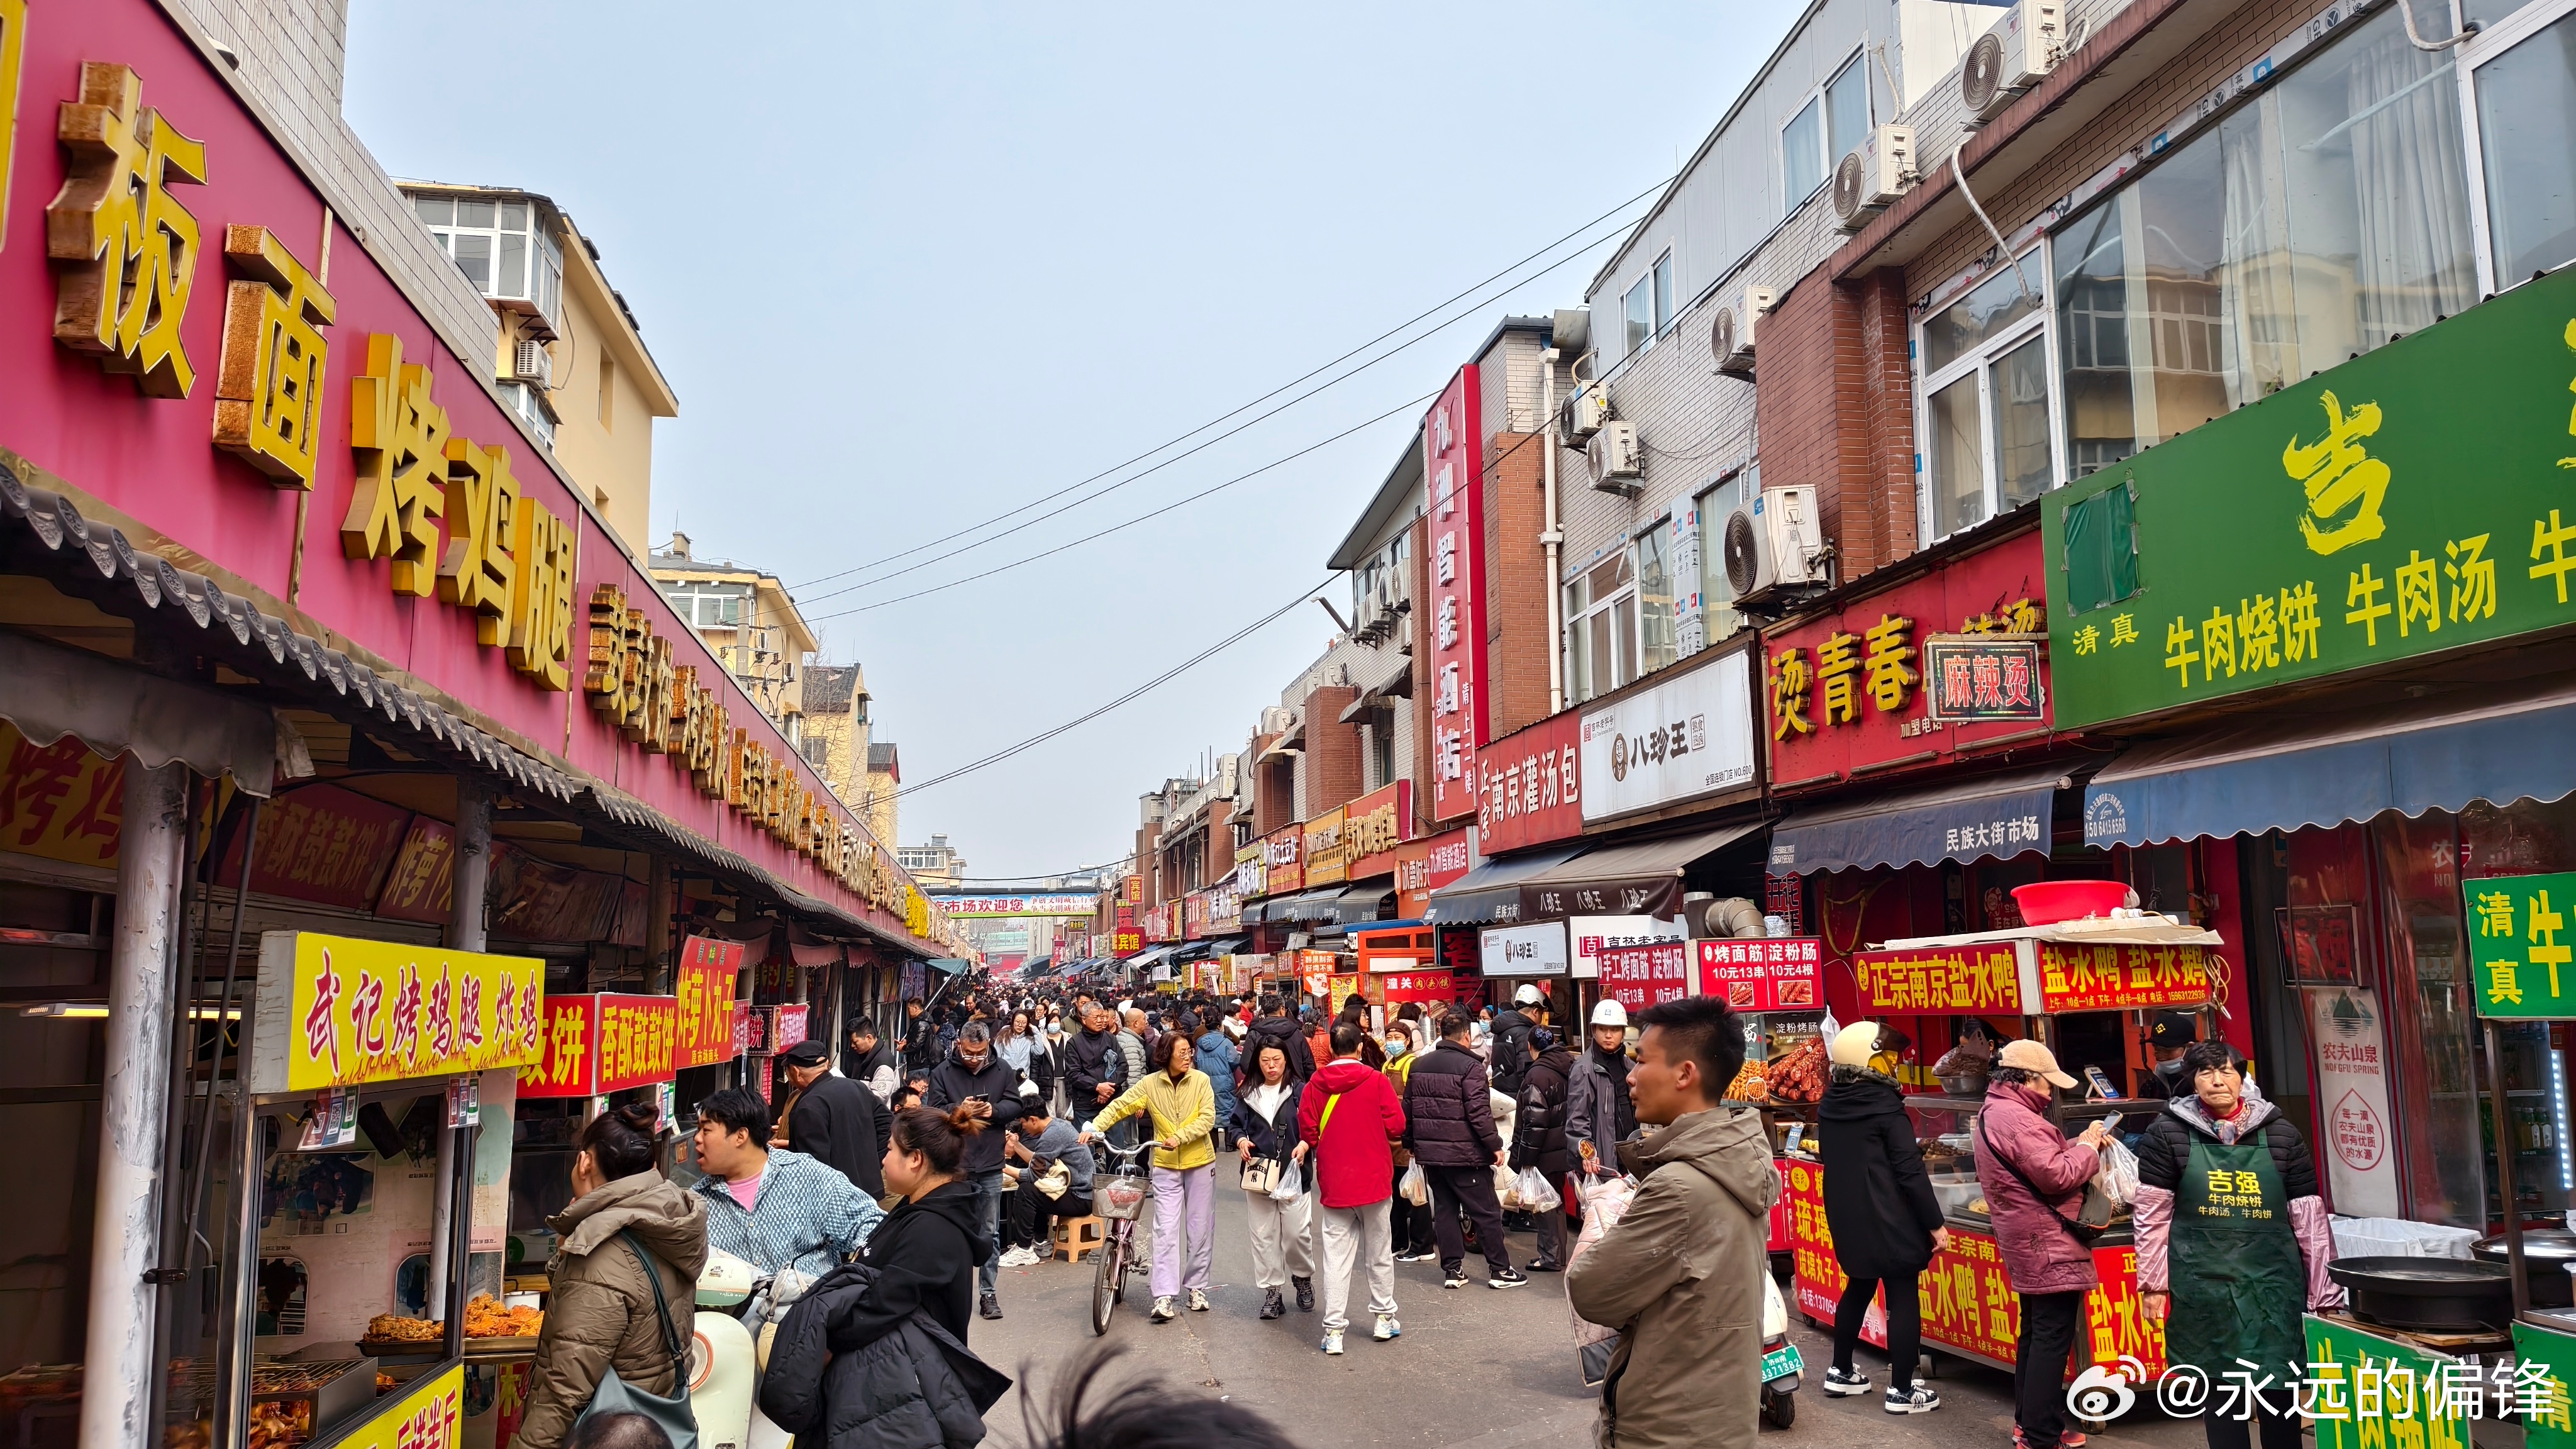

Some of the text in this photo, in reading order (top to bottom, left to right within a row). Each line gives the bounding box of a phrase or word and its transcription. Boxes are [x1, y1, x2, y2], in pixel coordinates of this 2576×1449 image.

[0, 0, 336, 491] 板面
[341, 332, 574, 691] 烤鸡腿
[2282, 389, 2391, 556] 吉
[1433, 406, 1460, 781] 九洲智能酒店
[2072, 613, 2140, 656] 清真
[2165, 580, 2322, 689] 牛肉烧饼
[2345, 532, 2497, 647] 牛肉汤
[1944, 655, 2031, 708] 麻辣烫
[1630, 719, 1689, 770] 八珍王
[1491, 743, 1579, 825] 南京灌汤包
[1734, 765, 1752, 778] NO.600
[1479, 758, 1491, 843] 正宗
[1946, 816, 2040, 853] 民族大街市场
[2085, 821, 2097, 838] 150
[1430, 840, 1467, 874] 九洲智能酒店
[1130, 880, 1141, 901] 宾馆
[1540, 892, 1564, 913] 八珍王
[1575, 890, 1606, 910] 八珍王
[1495, 903, 1520, 919] 民族大街
[1118, 933, 1140, 950] 宾馆
[1512, 941, 1533, 960] 八珍王
[1714, 943, 1817, 963] 烤面筋 淀粉肠
[2477, 891, 2523, 1005] 清真
[2528, 889, 2576, 997] 牛
[1603, 948, 1684, 982] 手工烤面筋 淀粉肠
[1713, 963, 1814, 979] 10元13串 10元4根
[1869, 948, 2019, 1009] 正宗南京盐水鸭
[2042, 944, 2207, 994] 盐水鸭 盐水鹅
[304, 946, 540, 1078] 武记烤鸡腿 炸鸡
[676, 965, 735, 1049] 炸萝卜丸子
[1615, 986, 1645, 1004] 10元13串
[601, 1004, 675, 1082] 香酥鼓鼓饼
[1775, 1021, 1818, 1034] 淀粉烤肠
[2323, 1041, 2378, 1063] 农夫山泉
[2338, 1121, 2374, 1135] 农夫山泉
[2345, 1146, 2373, 1160] 的水源
[2207, 1169, 2262, 1195] 吉强
[2208, 1193, 2263, 1208] 牛肉烧饼
[1945, 1233, 2004, 1262] 正宗南
[1797, 1246, 1835, 1288] 琉璃丸子
